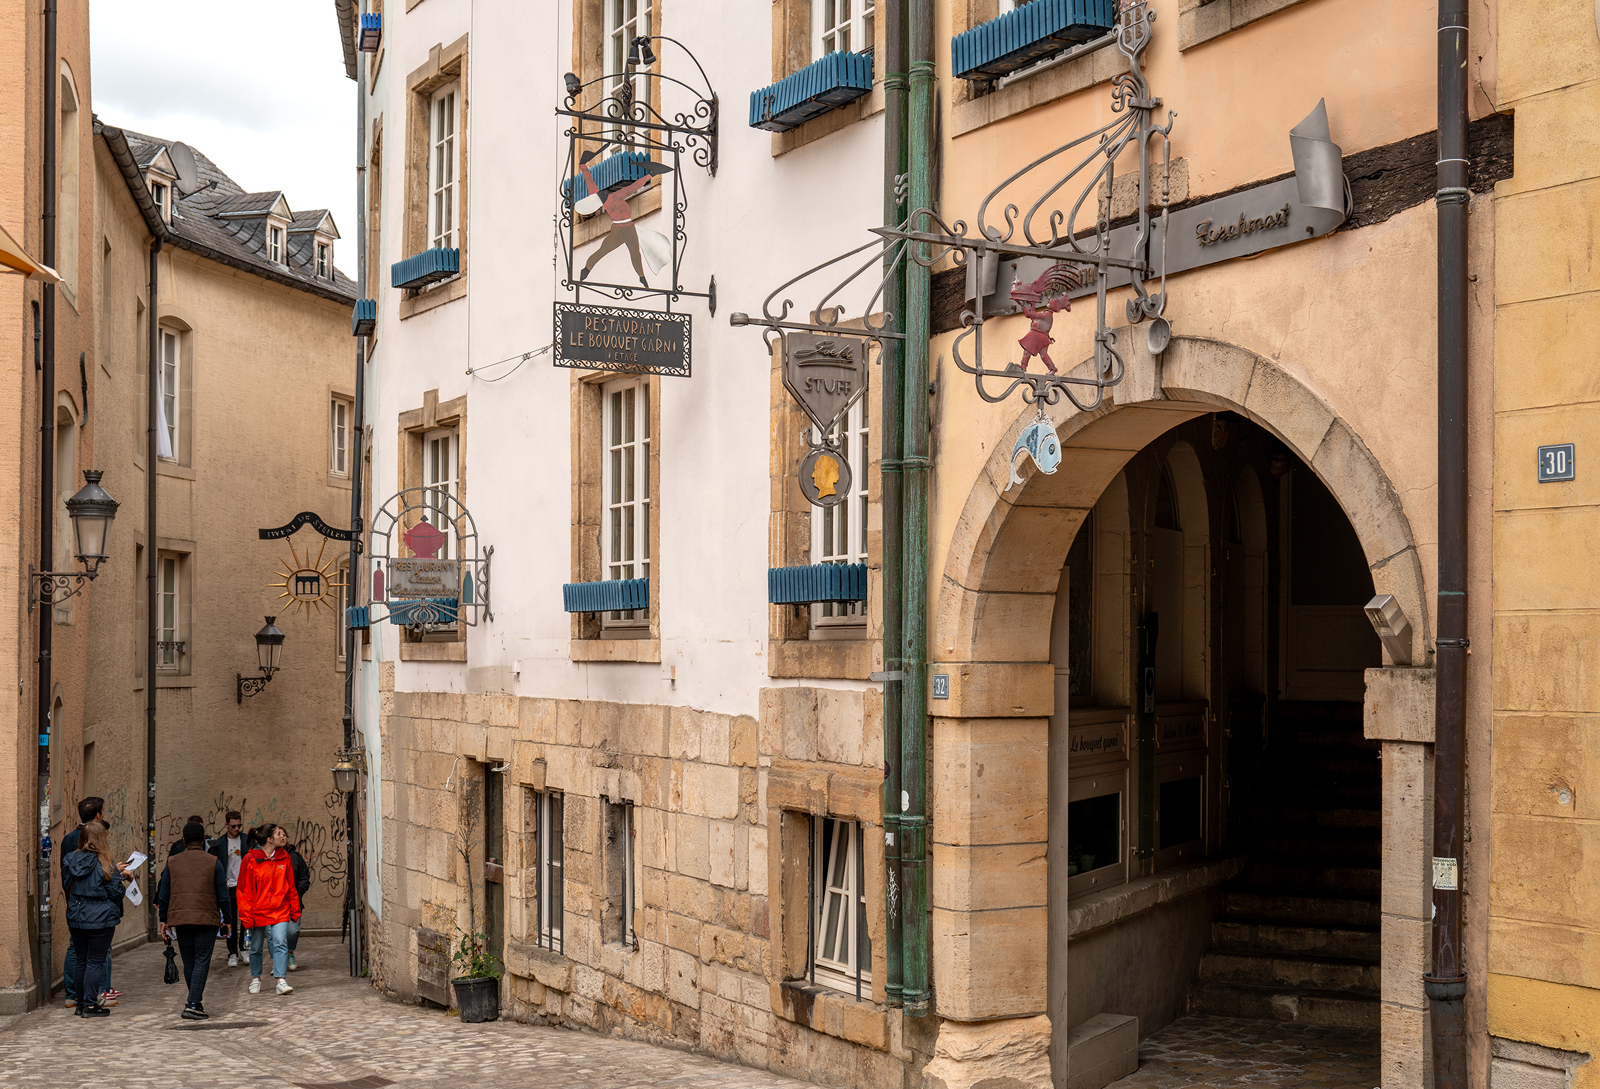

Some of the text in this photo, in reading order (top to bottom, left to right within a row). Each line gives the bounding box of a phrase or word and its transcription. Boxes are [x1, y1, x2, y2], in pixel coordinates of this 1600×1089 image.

[585, 316, 662, 337] RESTAURANT
[570, 332, 584, 347] LE
[588, 333, 638, 351] BOUQUET
[804, 376, 852, 396] STUFF
[1546, 450, 1566, 475] 30
[395, 561, 454, 572] RESTAURANT
[935, 678, 945, 695] 32
